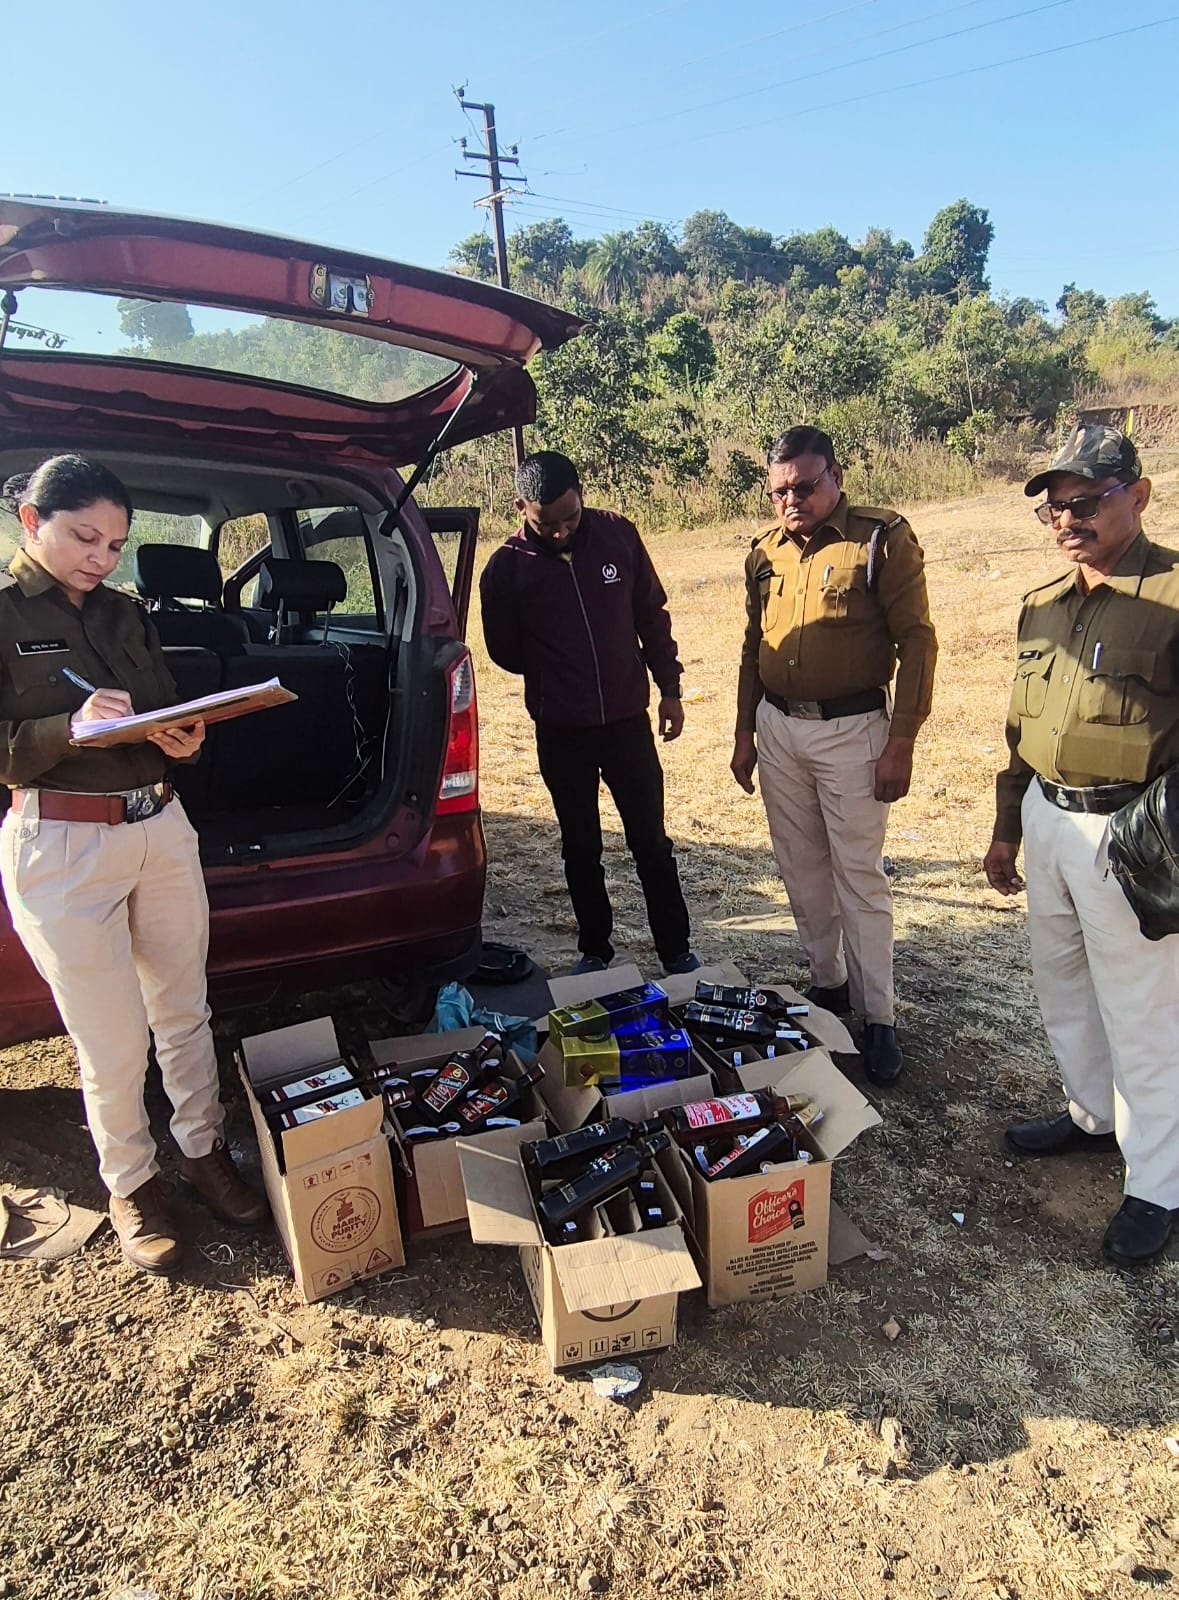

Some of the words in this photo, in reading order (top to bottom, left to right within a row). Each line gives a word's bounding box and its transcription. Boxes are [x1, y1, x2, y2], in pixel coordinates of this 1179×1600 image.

[754, 1187, 798, 1216] Officer's
[332, 1215, 361, 1231] MARK
[752, 1207, 787, 1229] Choice
[331, 1219, 367, 1240] PURITY
